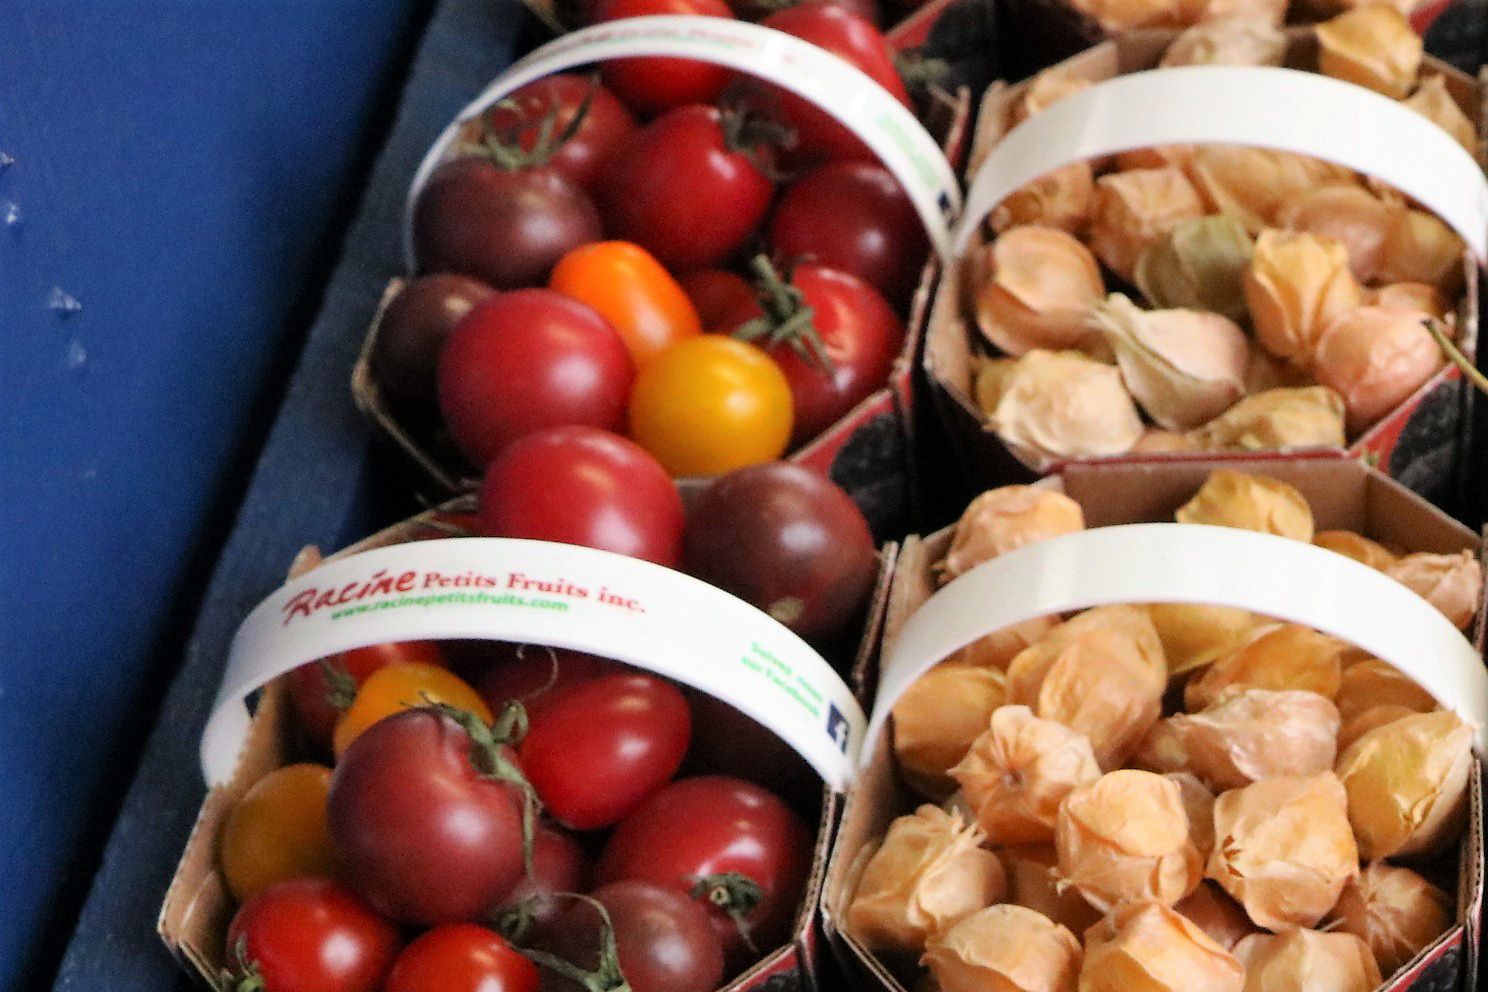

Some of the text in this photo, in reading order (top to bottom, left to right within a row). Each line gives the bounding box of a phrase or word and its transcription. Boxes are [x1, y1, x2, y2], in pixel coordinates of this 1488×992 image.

[281, 569, 648, 626] Racine Petits Fruits inc.
